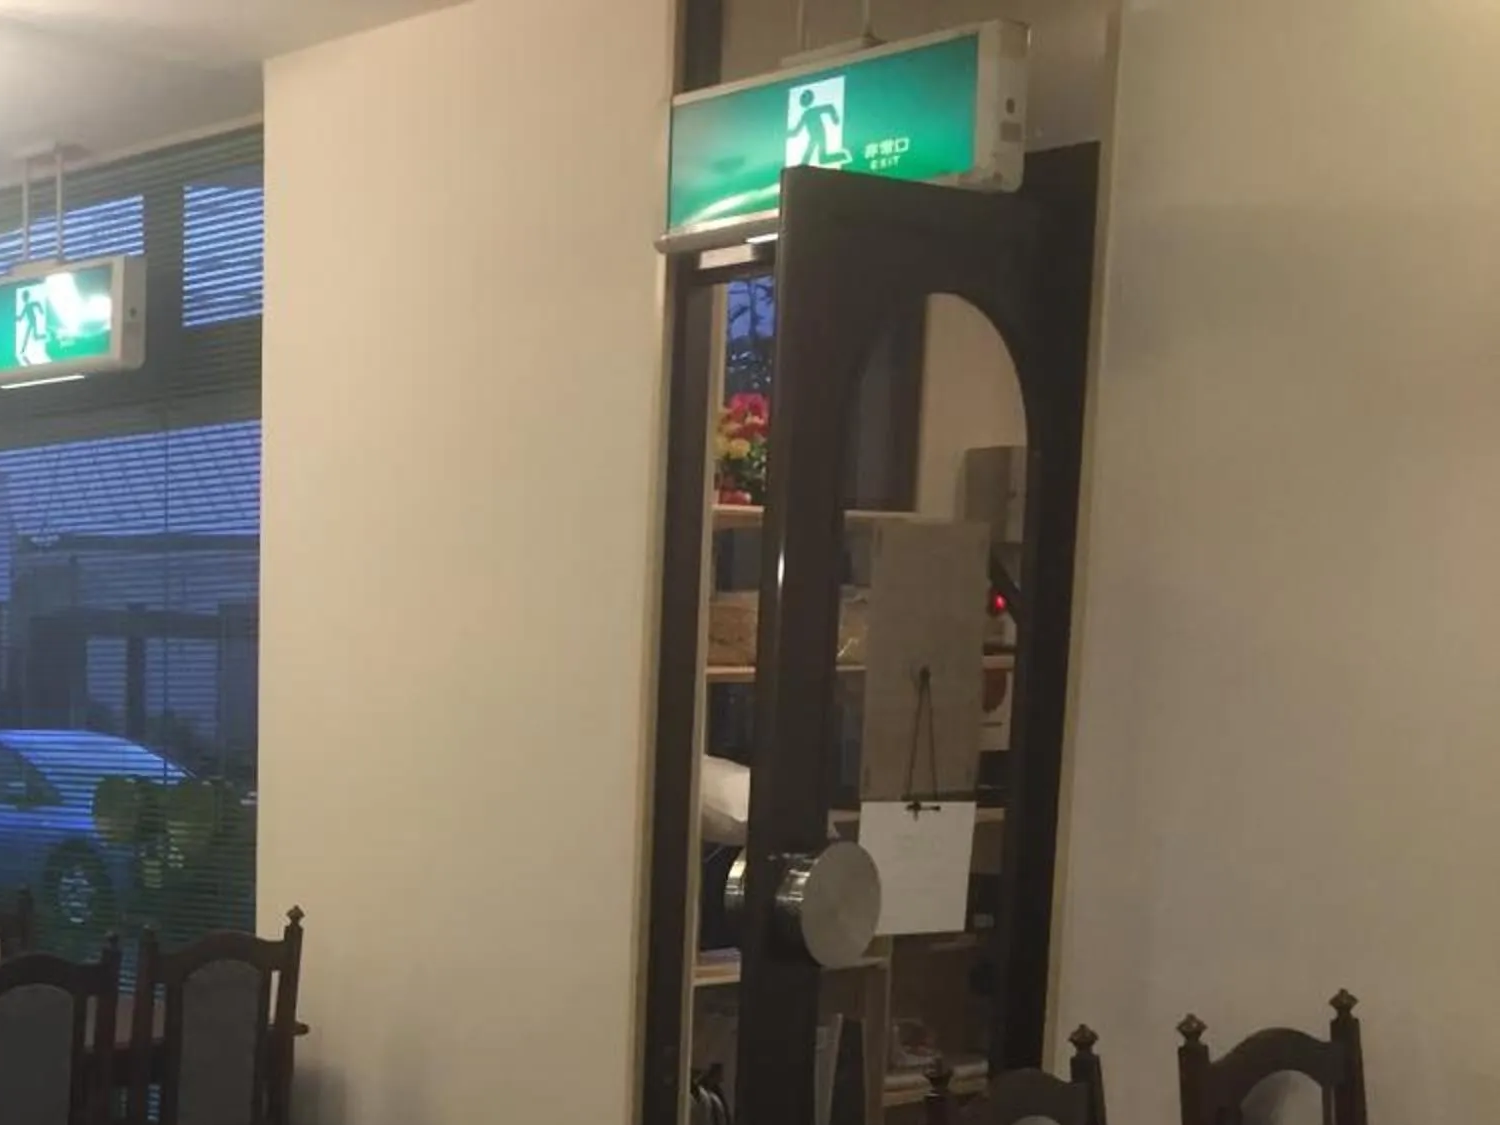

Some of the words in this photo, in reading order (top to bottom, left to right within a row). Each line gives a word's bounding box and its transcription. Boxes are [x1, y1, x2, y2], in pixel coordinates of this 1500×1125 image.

[865, 137, 910, 159] 非常口
[870, 155, 900, 170] EXIT
